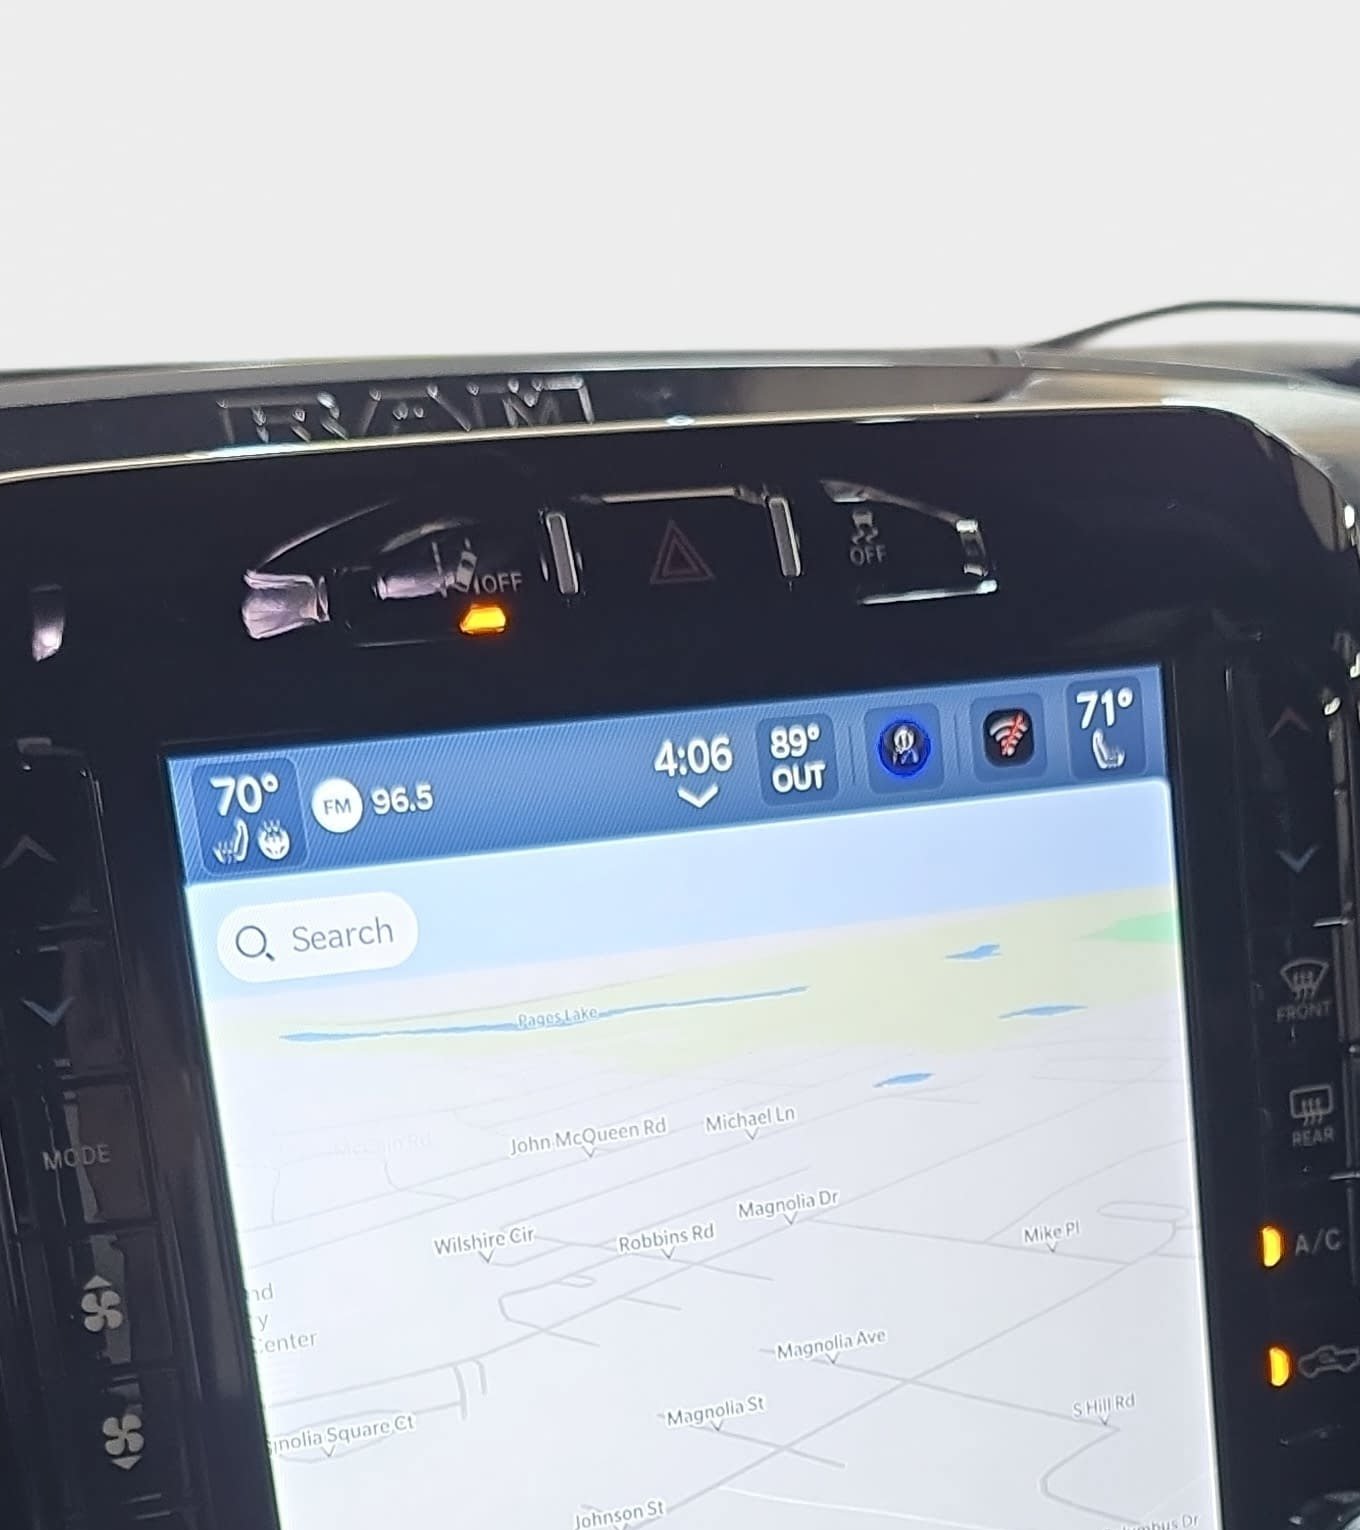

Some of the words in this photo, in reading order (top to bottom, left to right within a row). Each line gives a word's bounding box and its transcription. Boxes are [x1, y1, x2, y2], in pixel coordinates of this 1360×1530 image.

[217, 374, 594, 443] RAM
[849, 545, 889, 566] OFF
[481, 571, 523, 594] OFF
[1074, 689, 1133, 728] 71°
[653, 735, 734, 777] 4:06
[769, 724, 820, 760] 89°
[771, 759, 825, 793] OUT
[210, 771, 278, 818] 70°
[322, 795, 352, 817] FM
[370, 781, 434, 819] 96.5
[292, 914, 394, 953] Search
[518, 1012, 561, 1028] Pages
[564, 1006, 598, 1022] Lake
[1277, 1000, 1332, 1023] FRONT
[706, 1109, 771, 1131] Michael
[776, 1106, 795, 1122] Ln
[511, 1137, 550, 1155] John
[555, 1124, 639, 1149] McQueen
[644, 1117, 666, 1136] Rd
[1292, 1127, 1334, 1148] REAR
[42, 1143, 111, 1171] MODE
[738, 1195, 815, 1218] Magnolia
[818, 1190, 838, 1206] Dr
[435, 1232, 505, 1255] Wilshire
[510, 1226, 534, 1244] Cir
[620, 1229, 688, 1252] Robbins
[692, 1223, 714, 1241] Rd
[1024, 1225, 1062, 1243] Mike
[1066, 1220, 1080, 1236] Pl
[1295, 1228, 1342, 1257] A/C
[259, 1332, 318, 1353] enter
[778, 1334, 853, 1360] Magnolia
[858, 1330, 886, 1345] Ave
[667, 1400, 744, 1426] Magnolia
[748, 1396, 764, 1411] St
[1073, 1402, 1082, 1417] S
[1086, 1397, 1111, 1415] Hill
[1115, 1392, 1135, 1409] Rd
[326, 1421, 390, 1444] Square
[394, 1415, 414, 1431] Ct
[575, 1507, 643, 1530] Johnson
[647, 1501, 664, 1516] St
[1182, 1514, 1200, 1529] Dr
